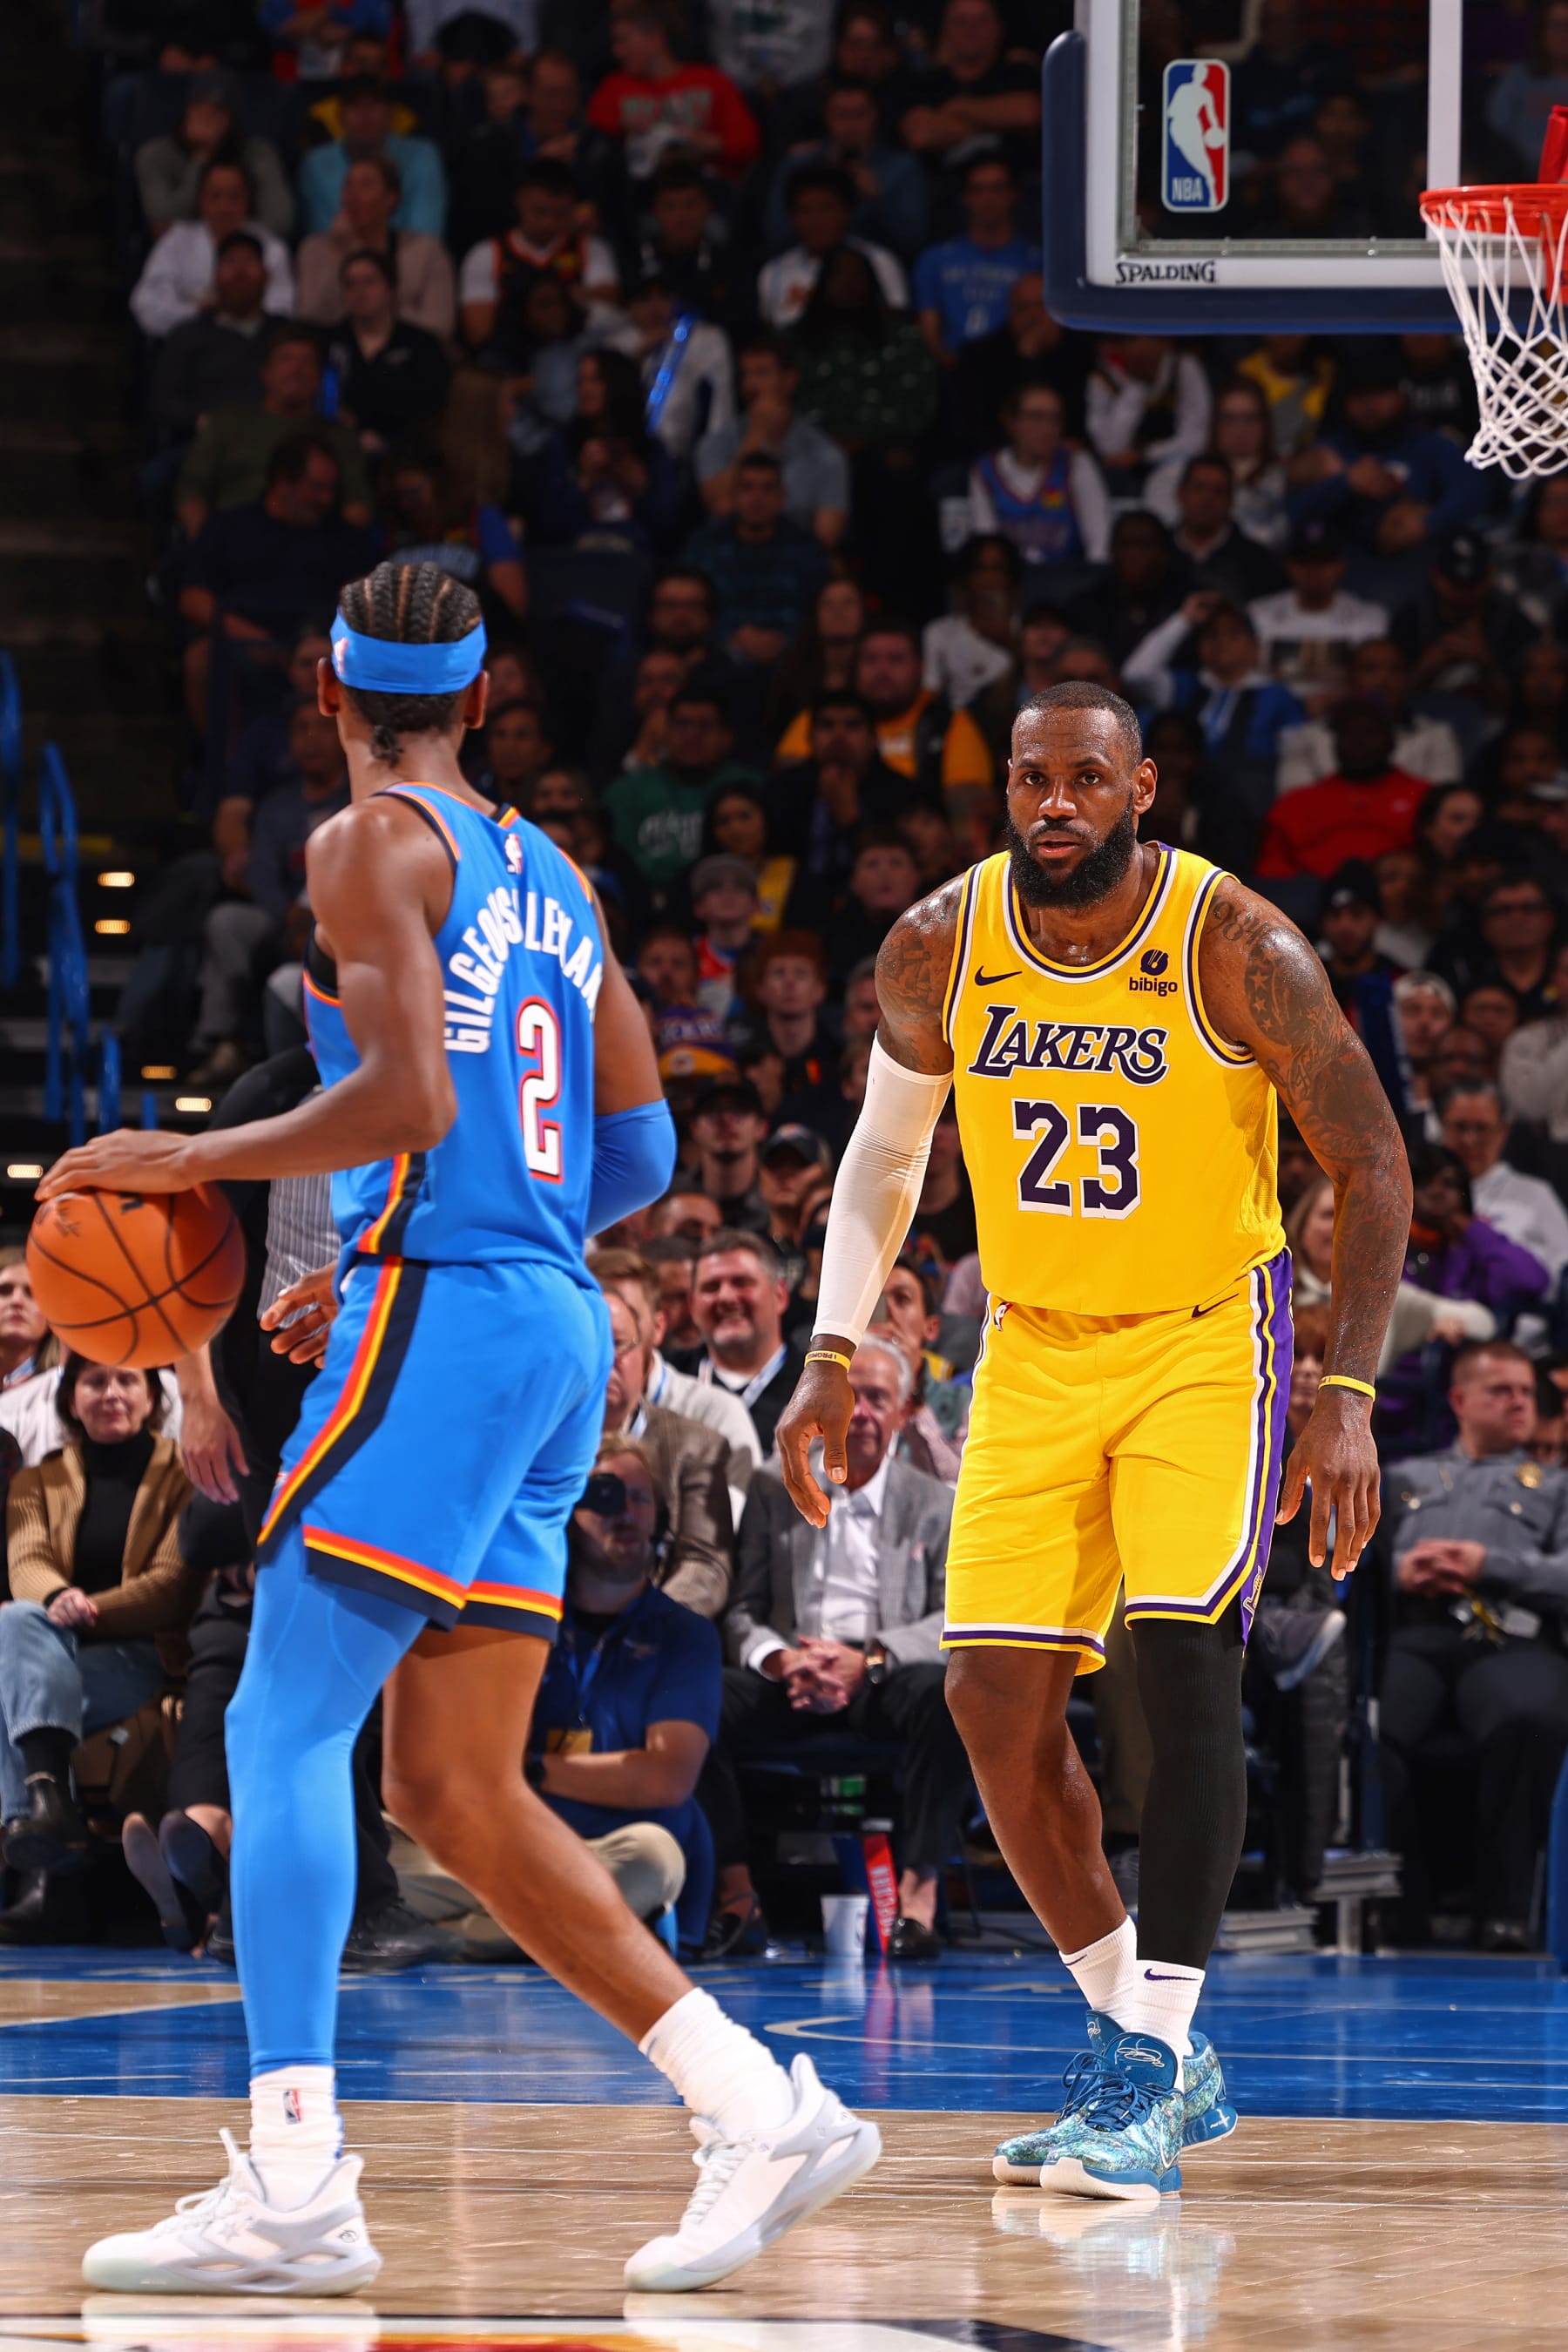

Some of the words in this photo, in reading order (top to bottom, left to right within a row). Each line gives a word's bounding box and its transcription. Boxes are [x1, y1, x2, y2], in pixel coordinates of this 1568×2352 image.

[1172, 177, 1204, 202] NBA
[1116, 260, 1215, 284] SPALDING
[1129, 977, 1178, 997] bibigo
[966, 1004, 1171, 1087] LAKERS
[515, 995, 564, 1186] 2
[1010, 1098, 1142, 1220] 23
